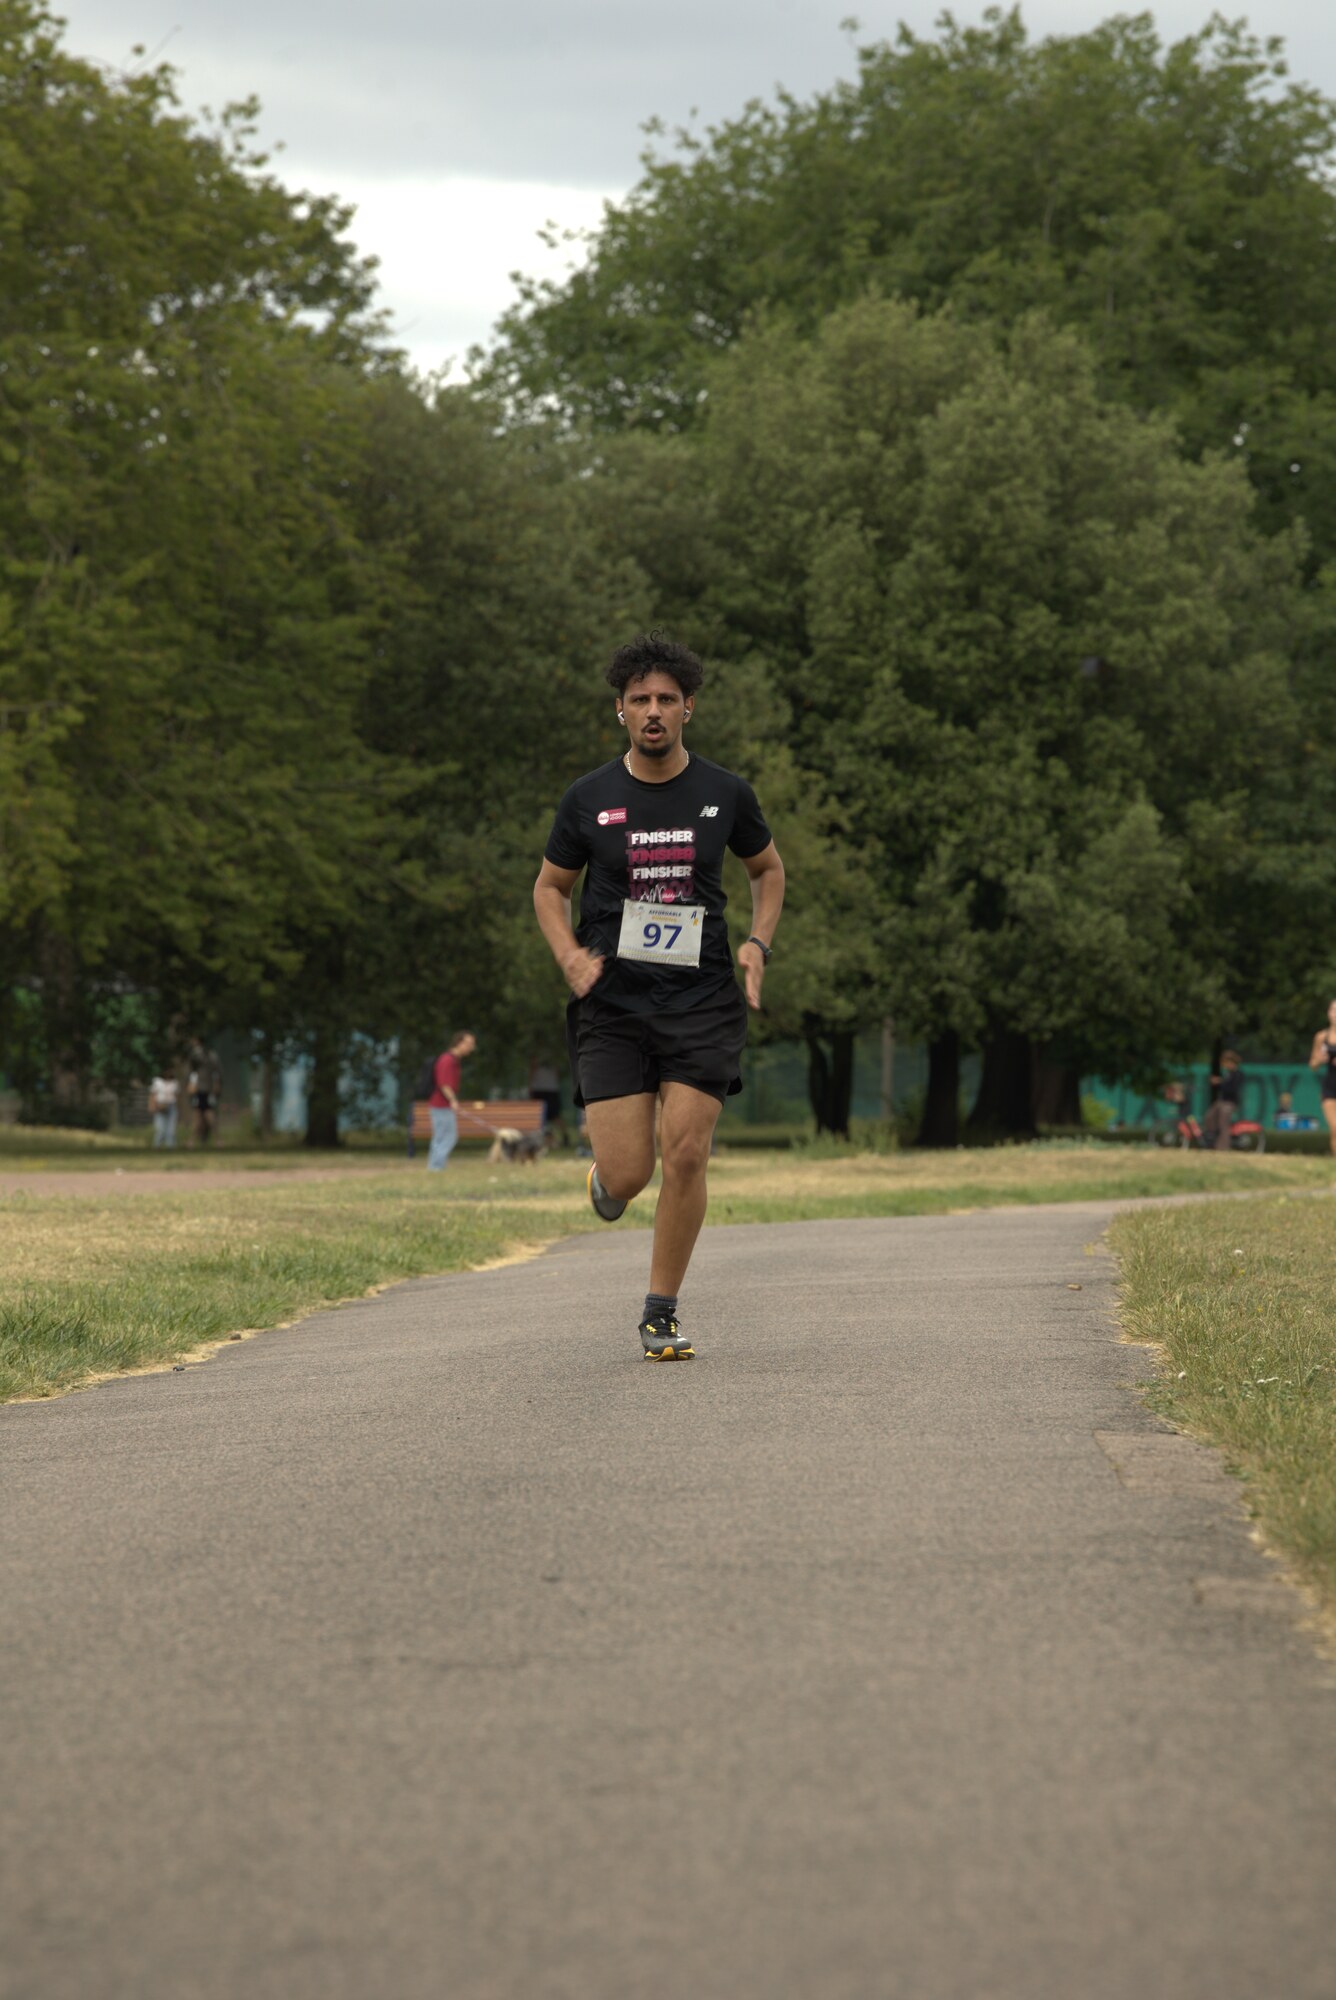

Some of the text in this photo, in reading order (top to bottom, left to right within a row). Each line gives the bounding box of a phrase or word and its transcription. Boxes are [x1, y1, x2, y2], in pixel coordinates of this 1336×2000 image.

[631, 830, 693, 845] FINISHER
[632, 866, 692, 880] FINISHER
[642, 922, 682, 949] 97
